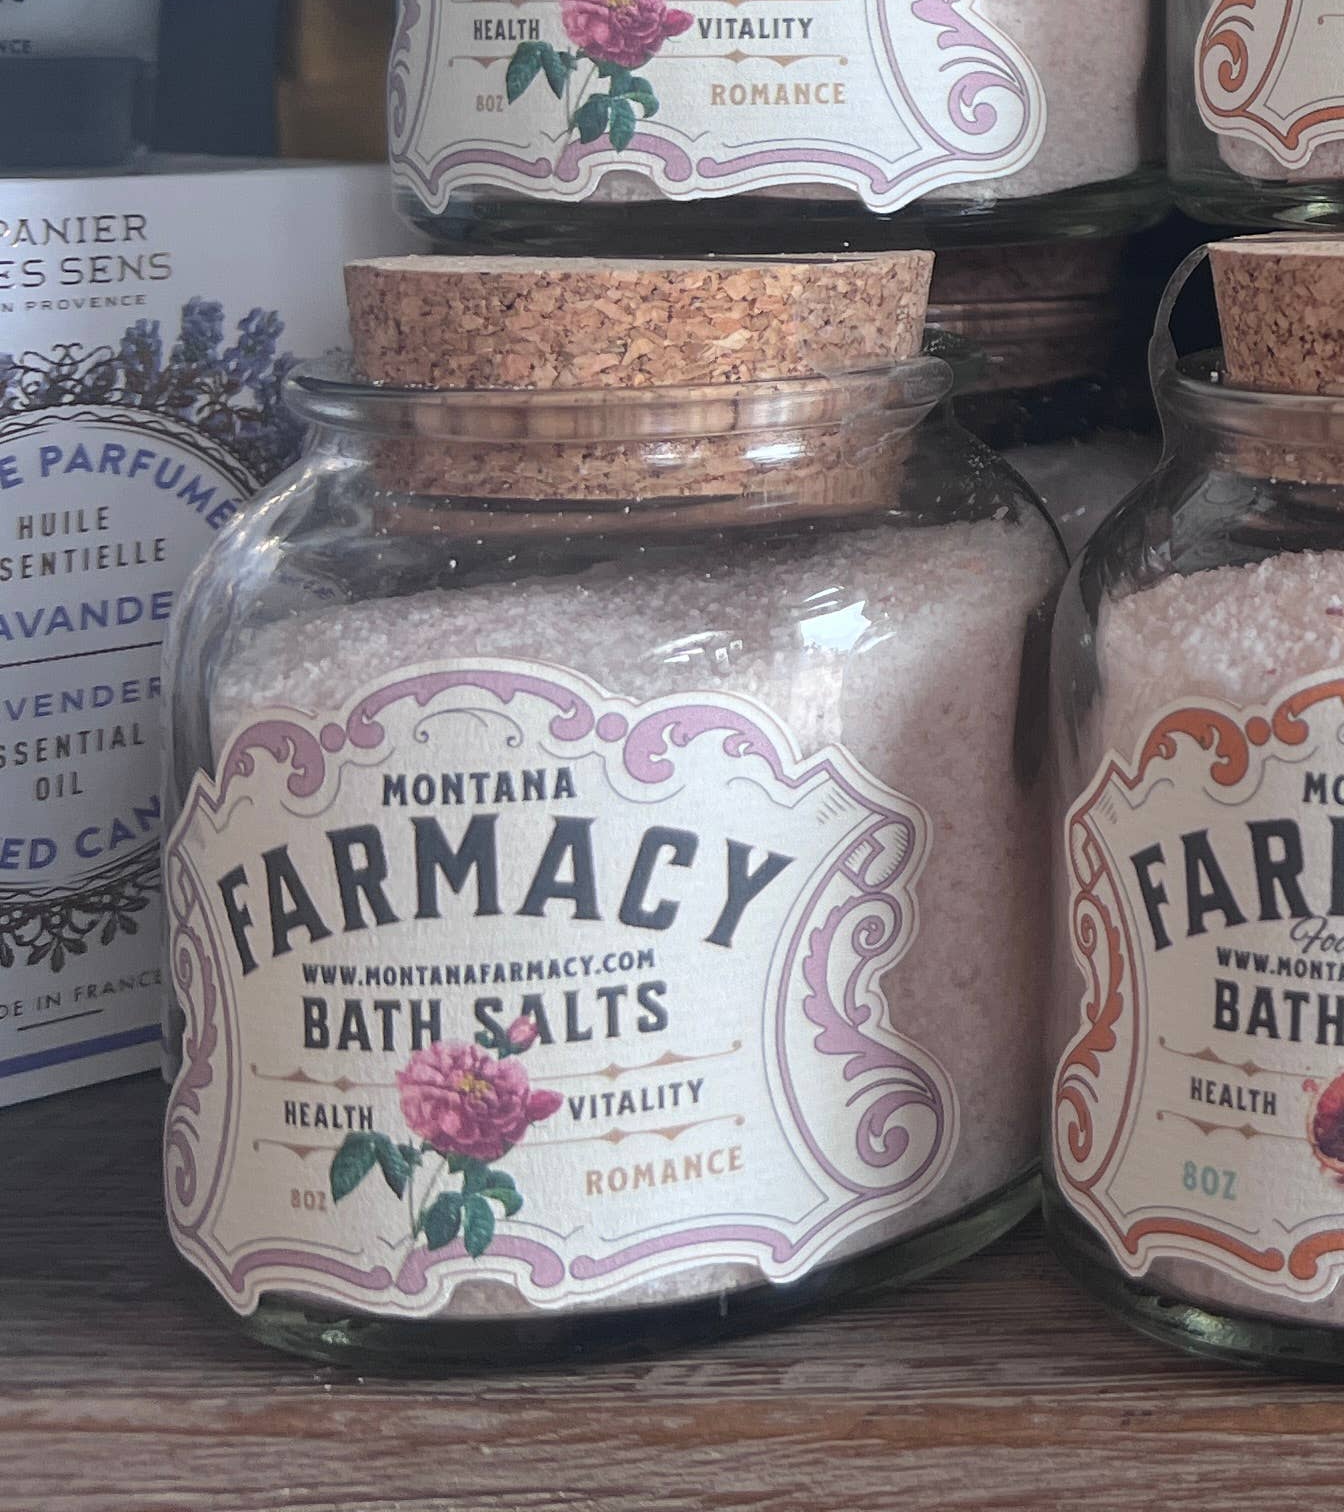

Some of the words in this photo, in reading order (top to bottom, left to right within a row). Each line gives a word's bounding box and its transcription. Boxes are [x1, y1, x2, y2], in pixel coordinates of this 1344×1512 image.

[473, 18, 540, 42] HEALTH
[698, 17, 813, 40] VITALITY
[710, 82, 846, 106] ROMANCE
[60, 252, 173, 285] SENS
[26, 294, 147, 311] PROVENCE
[40, 443, 243, 530] PARFUMÉ
[17, 506, 110, 540] HUILE
[35, 771, 84, 802] OIL
[382, 767, 577, 806] MONTANA
[217, 814, 795, 976] FARMACY
[302, 948, 655, 987] WWW.MONTANAFARMACY.COM
[36, 989, 61, 1011] IN
[303, 995, 442, 1051] BATH
[474, 980, 668, 1048] SALTS
[284, 1100, 373, 1131] HEALTH
[568, 1078, 704, 1121] VITALITY
[1190, 1076, 1278, 1116] HEALTH
[585, 1146, 744, 1196] ROMANCE
